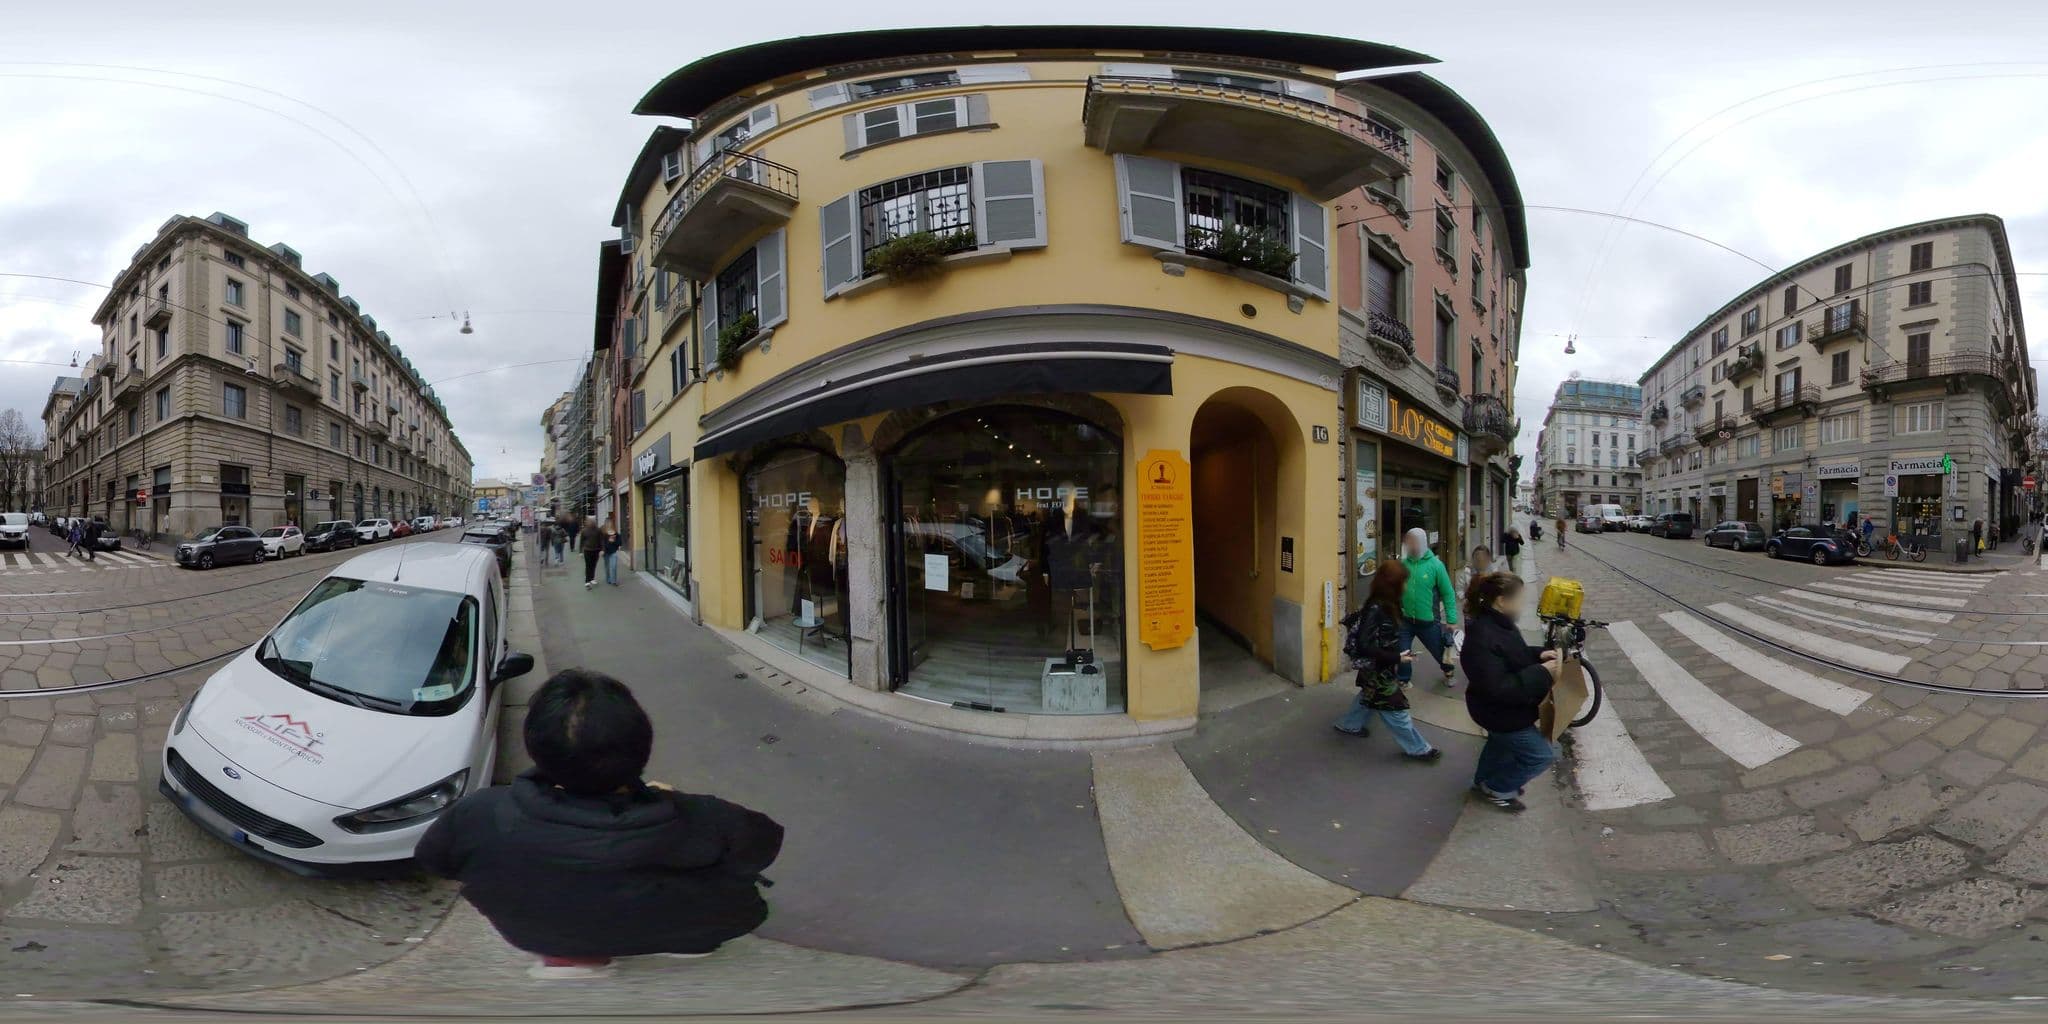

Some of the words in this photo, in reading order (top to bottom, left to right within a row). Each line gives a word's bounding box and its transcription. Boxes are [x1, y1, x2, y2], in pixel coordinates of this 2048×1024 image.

[1316, 427, 1327, 440] 16
[1819, 464, 1859, 475] Farmacia
[1890, 459, 1943, 470] Farmacia
[759, 492, 811, 508] HOPE
[1017, 487, 1088, 500] HOPE
[268, 736, 322, 765] MONTACARICHI
